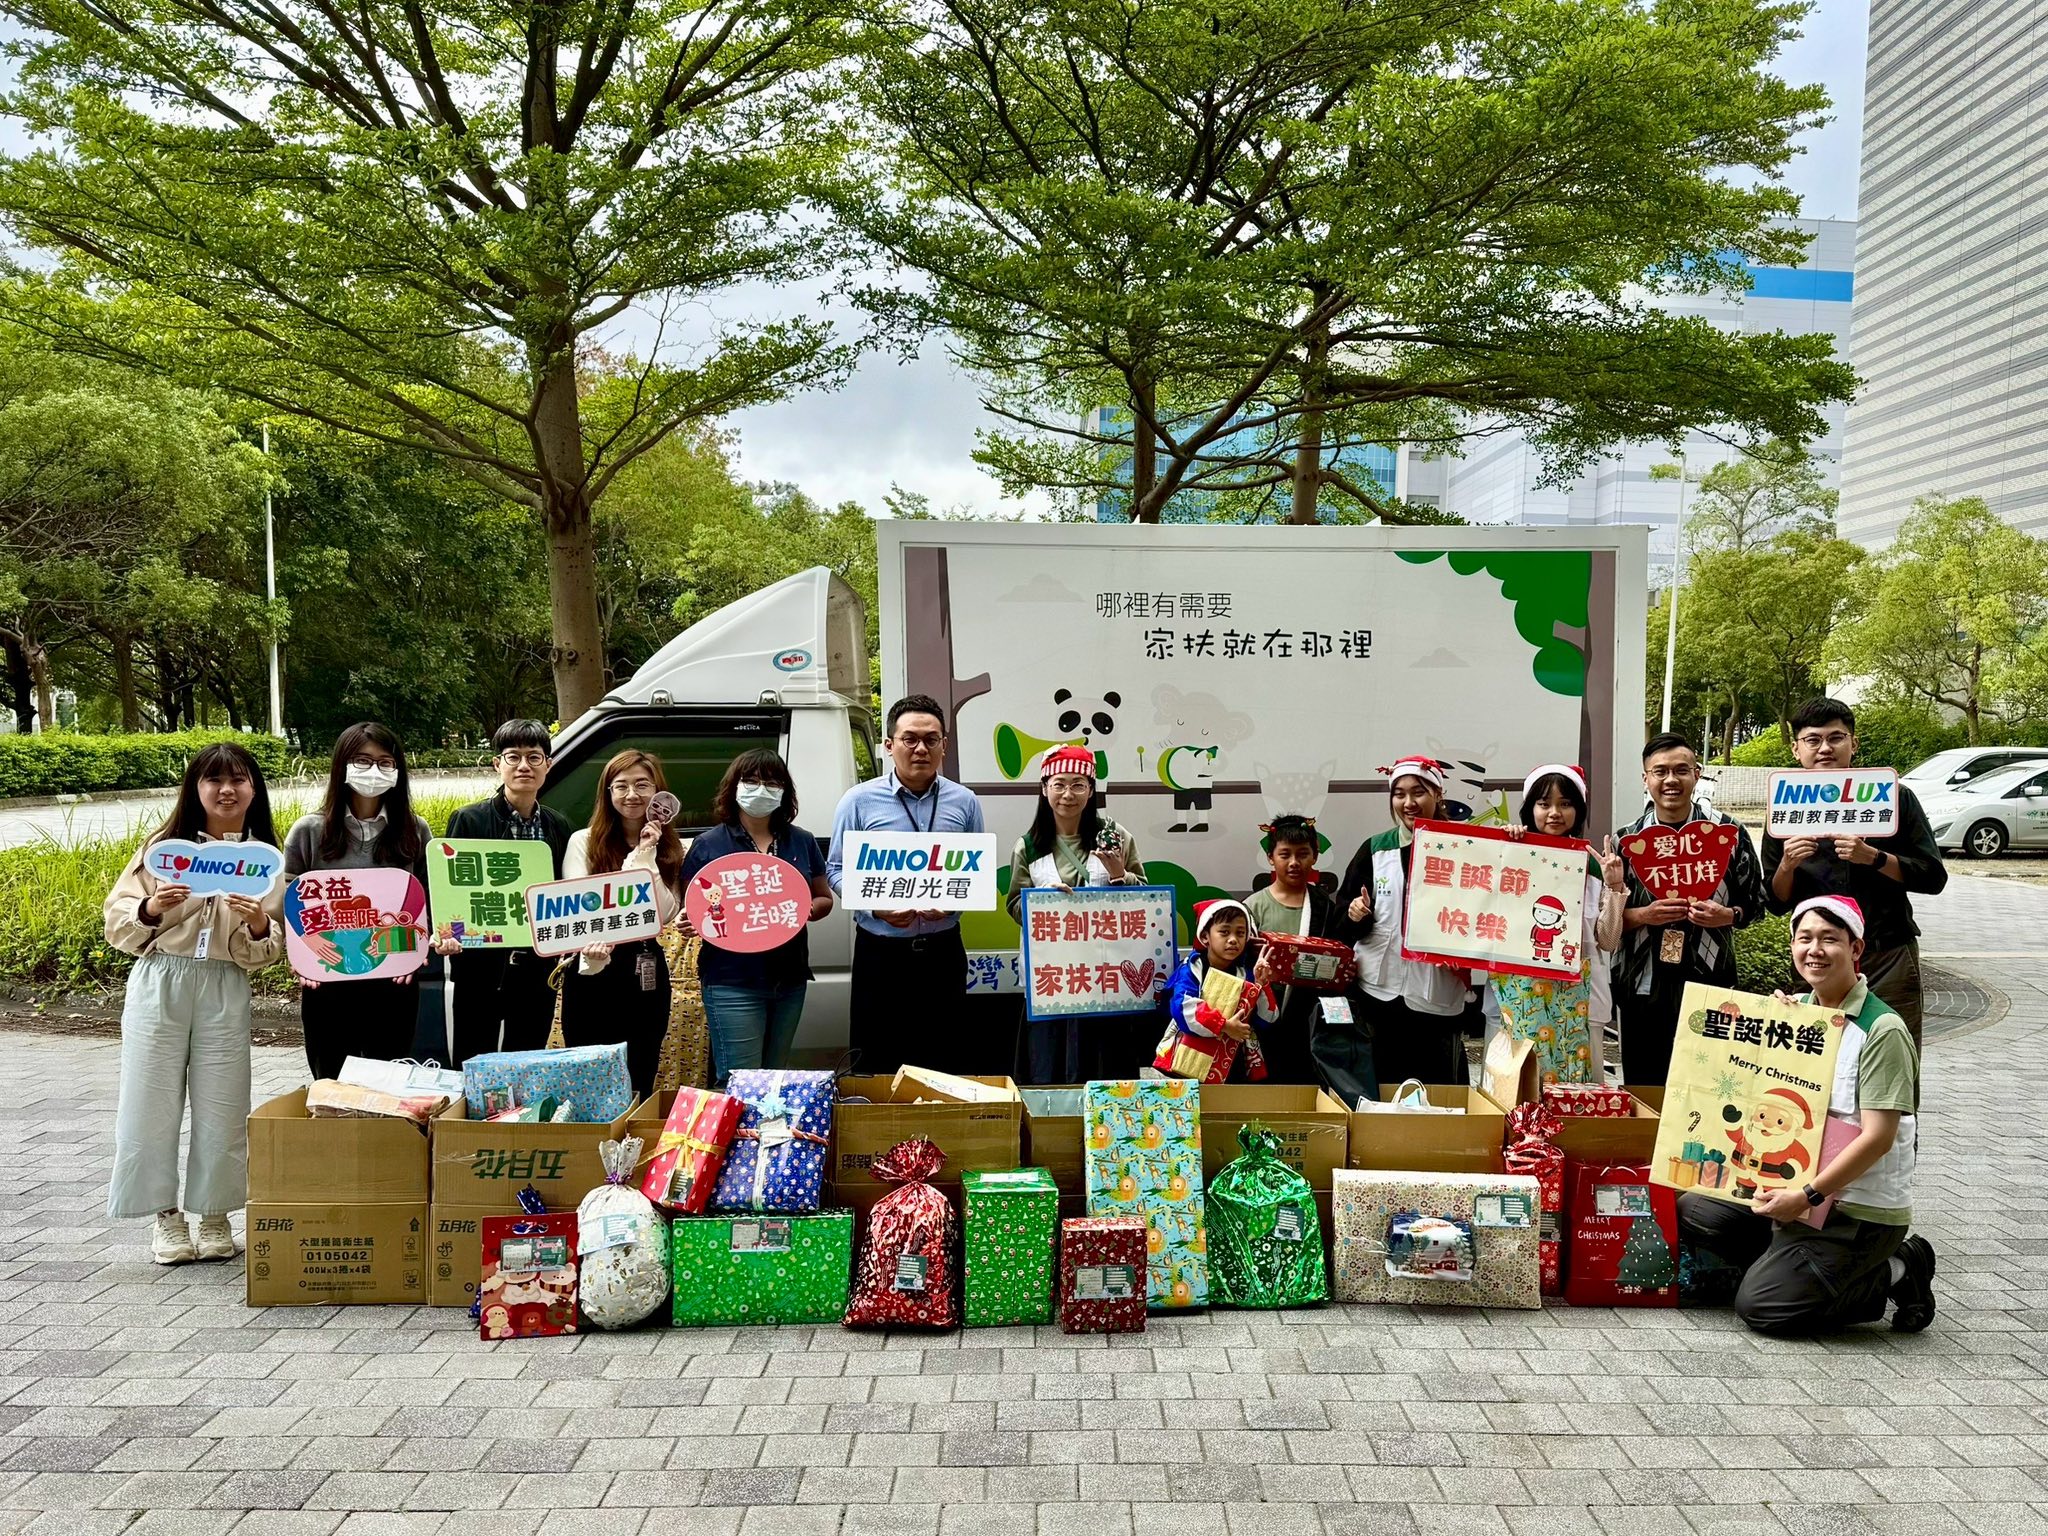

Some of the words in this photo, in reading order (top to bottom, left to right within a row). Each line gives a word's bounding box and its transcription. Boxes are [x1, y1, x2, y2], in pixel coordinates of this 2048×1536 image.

[1096, 591, 1232, 619] 哪裡有需要
[1144, 627, 1372, 660] 家扶就在那裡
[1771, 808, 1894, 825] 群創教育基金會
[1653, 834, 1703, 859] 愛心
[447, 851, 522, 888] 圓夢
[718, 863, 783, 901] 聖誕
[1423, 855, 1532, 898] 聖誕節
[1644, 860, 1721, 890] 不打烊
[297, 877, 352, 901] 公益
[860, 876, 972, 900] 群創光電
[299, 907, 380, 936] 愛無限
[536, 911, 657, 943] 群創教育基金會
[742, 901, 800, 933] 送暖
[1031, 908, 1148, 942] 群創送暖
[1436, 906, 1510, 943] 快樂
[1033, 961, 1122, 998] 家扶有
[1702, 1008, 1826, 1056] 聖誕快樂
[1728, 1054, 1763, 1075] Merry
[1765, 1066, 1822, 1092] Christmas
[471, 1149, 569, 1180] 五月花
[254, 1218, 294, 1232] 五月花
[437, 1220, 477, 1233] 五月花
[1577, 1230, 1620, 1240] CHRISTMAS
[306, 1251, 368, 1261] 0105042
